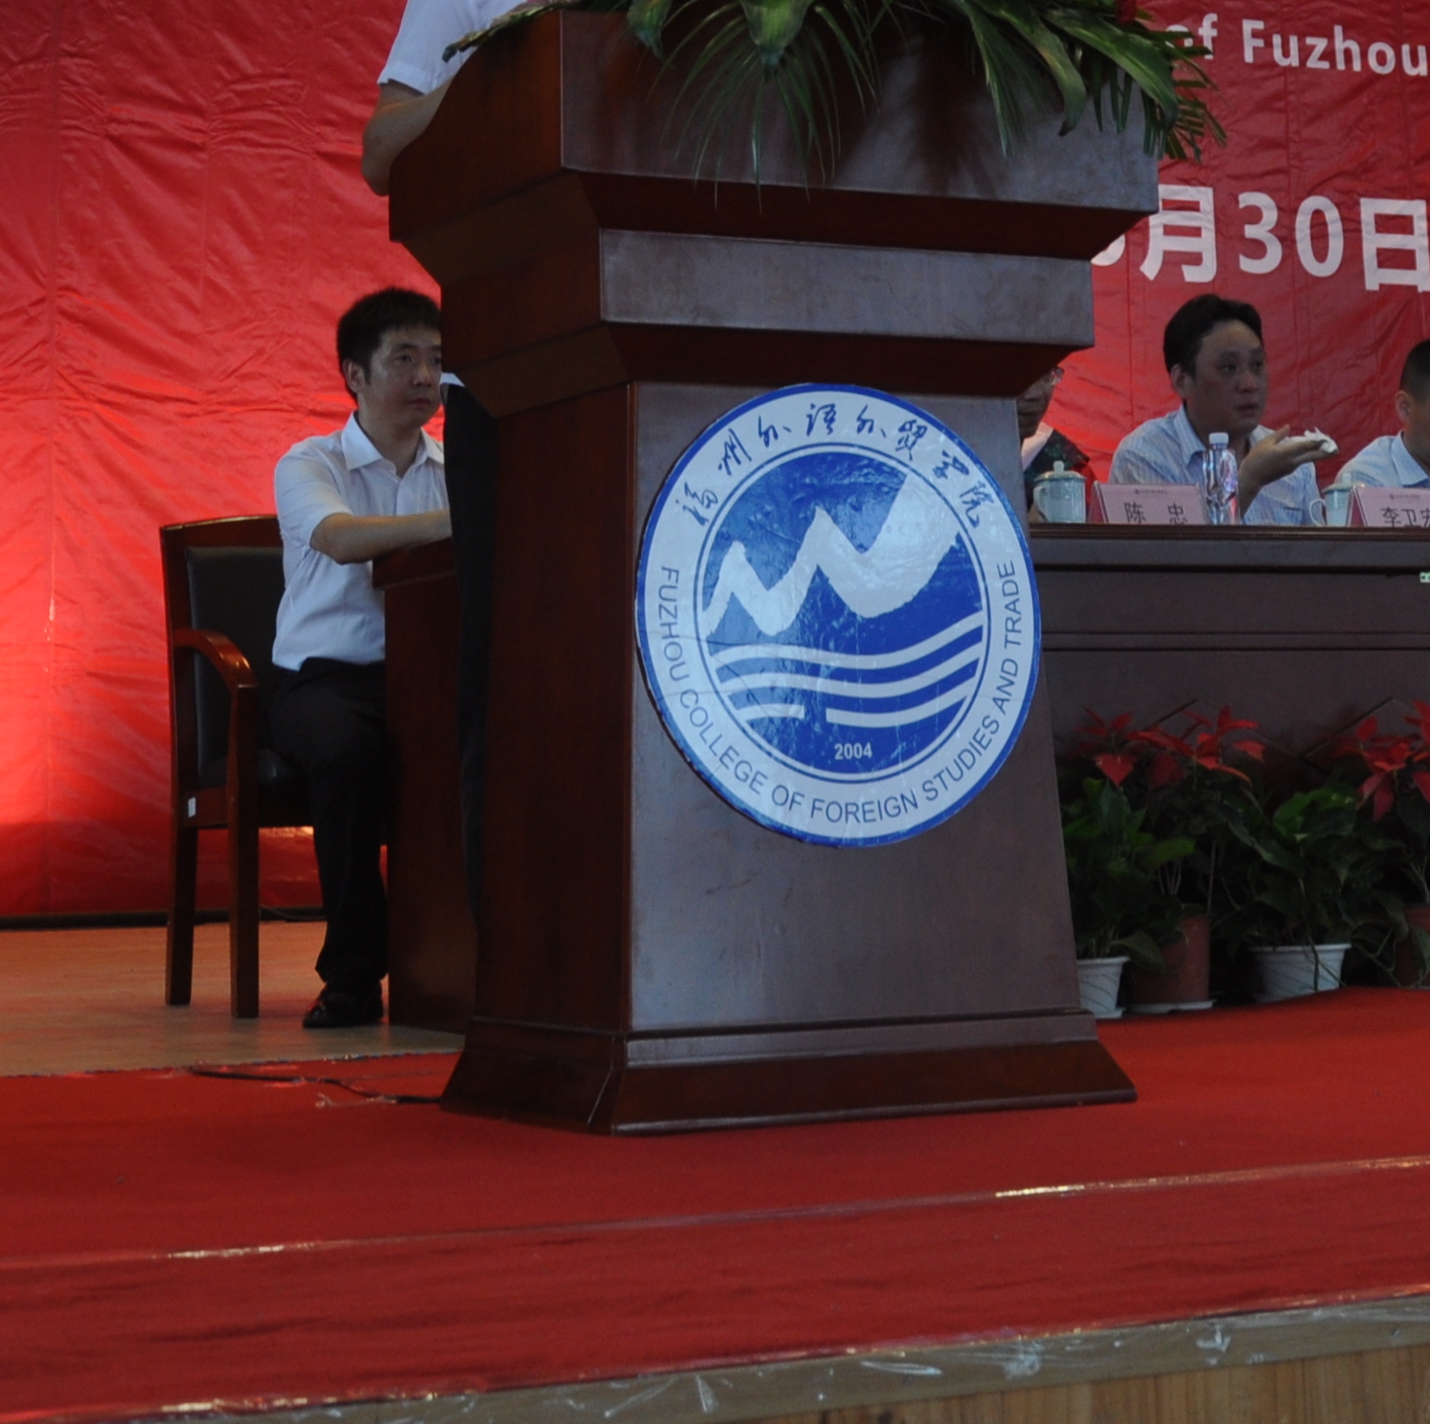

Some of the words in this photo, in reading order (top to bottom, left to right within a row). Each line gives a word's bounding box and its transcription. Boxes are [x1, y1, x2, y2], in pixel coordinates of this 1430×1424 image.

[1241, 18, 1429, 77] Fuzhou
[657, 565, 689, 683] FUZHOU
[996, 559, 1024, 655] TRADE
[993, 659, 1020, 715] AND
[679, 688, 769, 796] COLLEGE
[834, 741, 873, 761] 2004
[921, 716, 1001, 802] STUDIES
[771, 783, 806, 812] OF
[810, 792, 920, 825] FOREIGN
